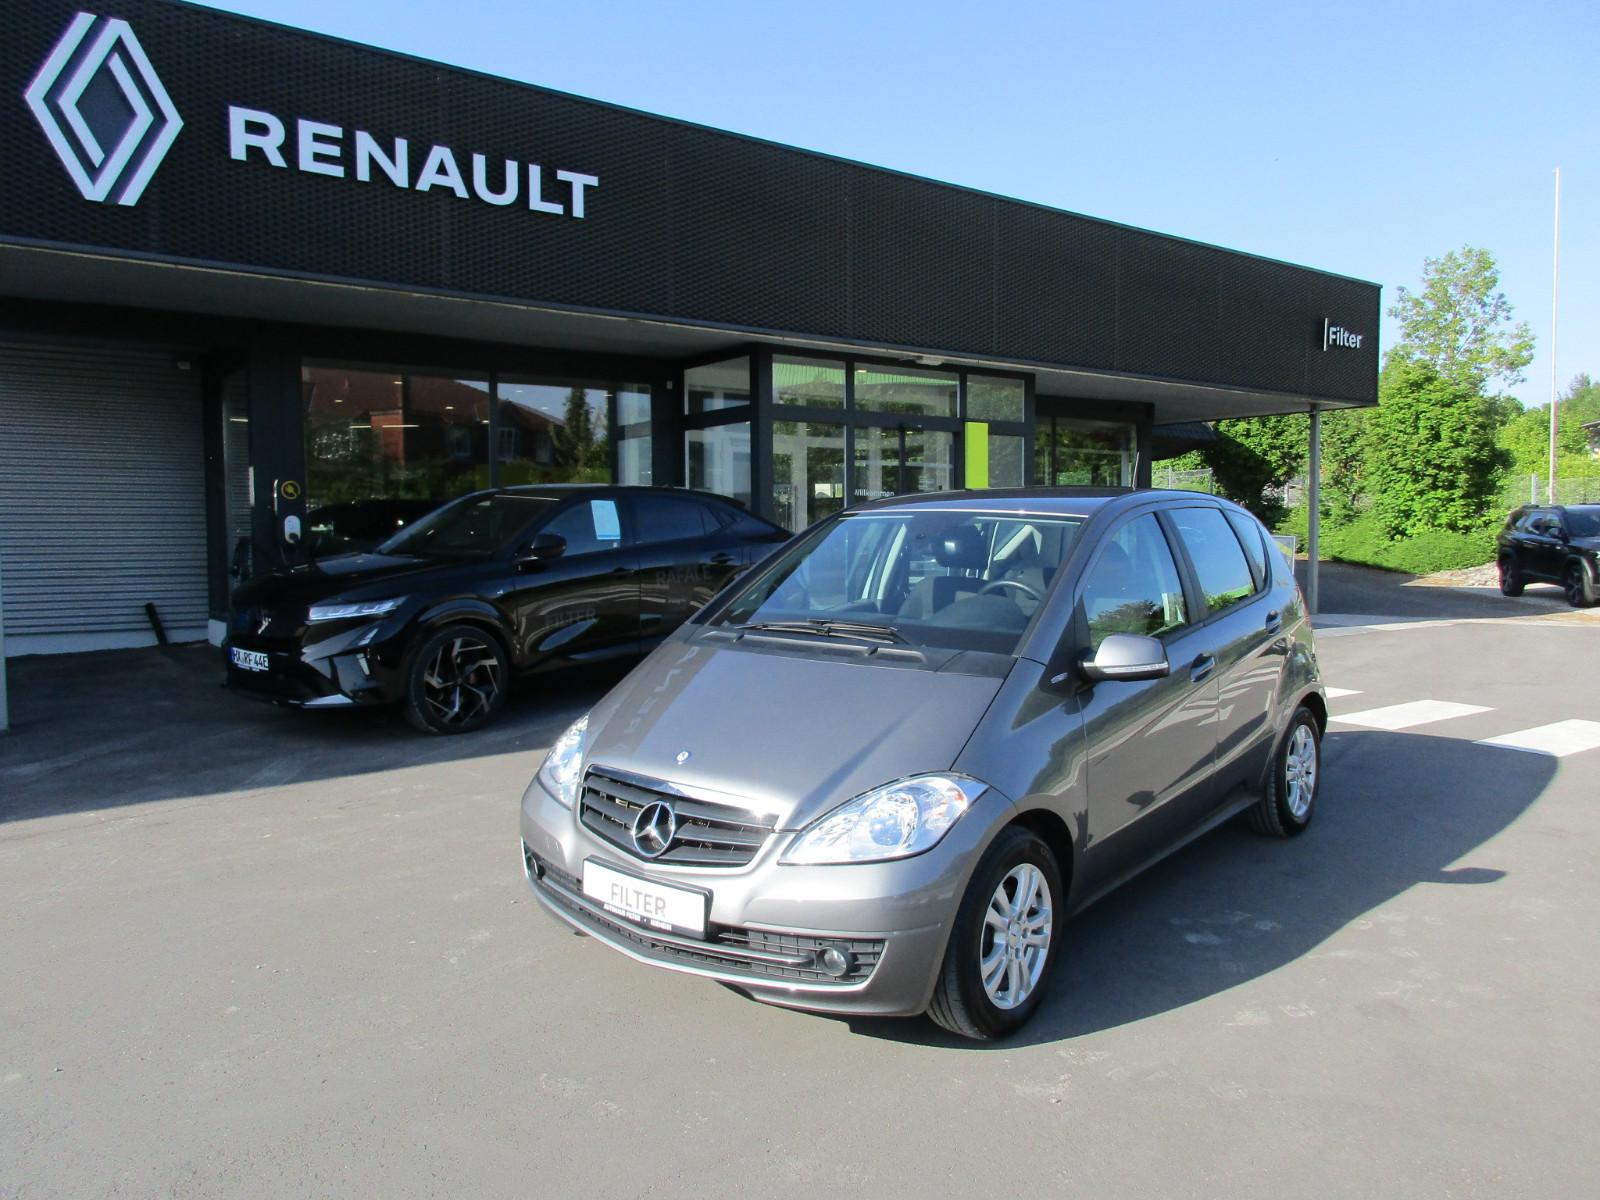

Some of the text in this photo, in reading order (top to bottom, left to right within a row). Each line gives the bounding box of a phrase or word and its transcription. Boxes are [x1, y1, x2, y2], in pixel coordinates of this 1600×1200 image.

[228, 105, 599, 218] RENAULT
[1329, 327, 1362, 349] Filter
[611, 883, 666, 916] FILTER
